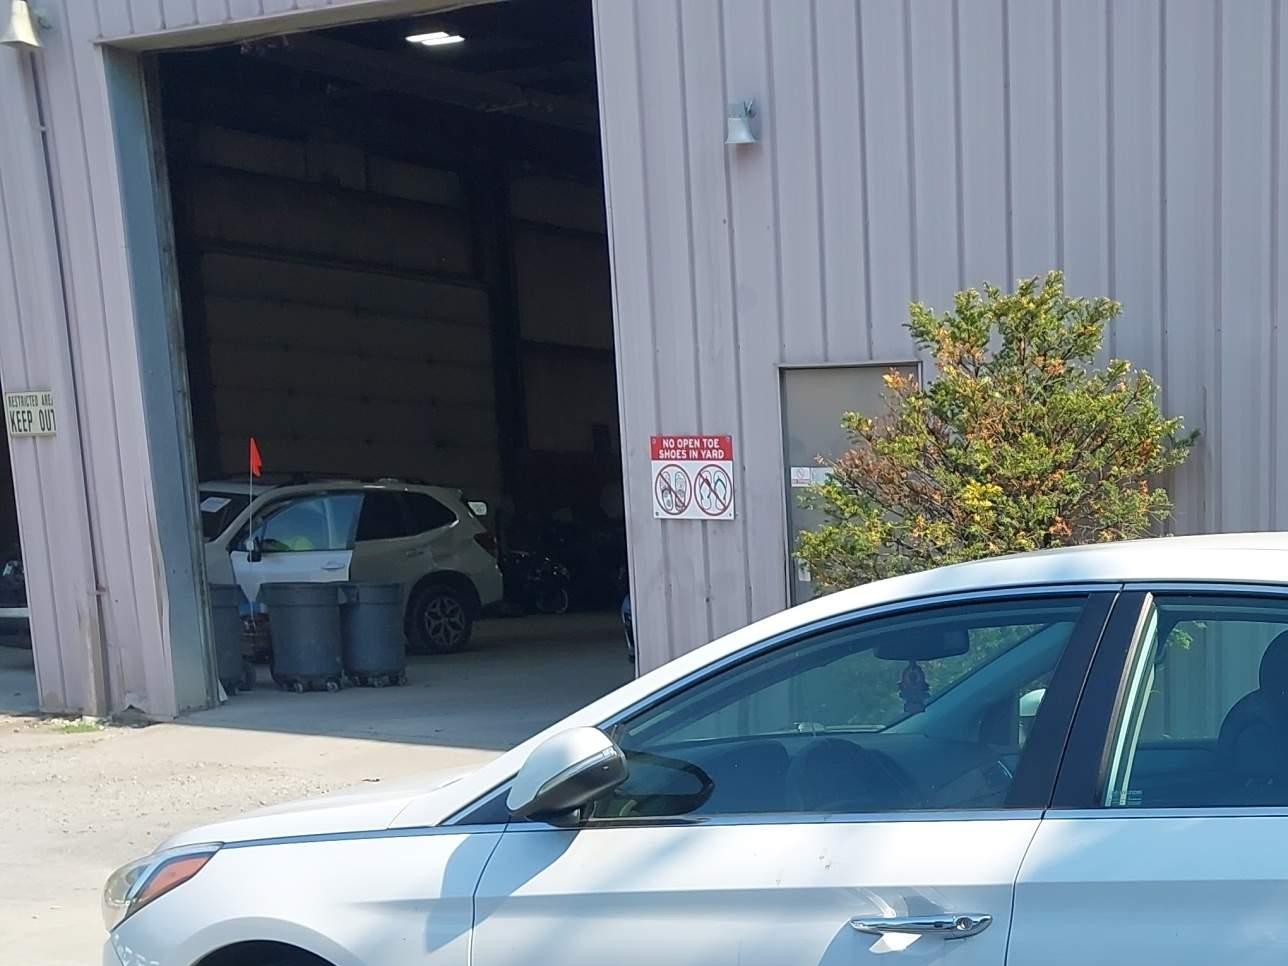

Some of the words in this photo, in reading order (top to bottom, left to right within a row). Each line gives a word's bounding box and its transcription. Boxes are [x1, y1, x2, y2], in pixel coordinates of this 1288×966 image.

[8, 394, 38, 407] RESTRICTED
[10, 410, 32, 432] KEEP
[662, 438, 675, 448] NO
[677, 438, 700, 448] OPEN
[702, 438, 720, 448] TOE
[658, 449, 687, 459] SHOES
[689, 450, 698, 459] IN
[700, 450, 725, 459] YARD
